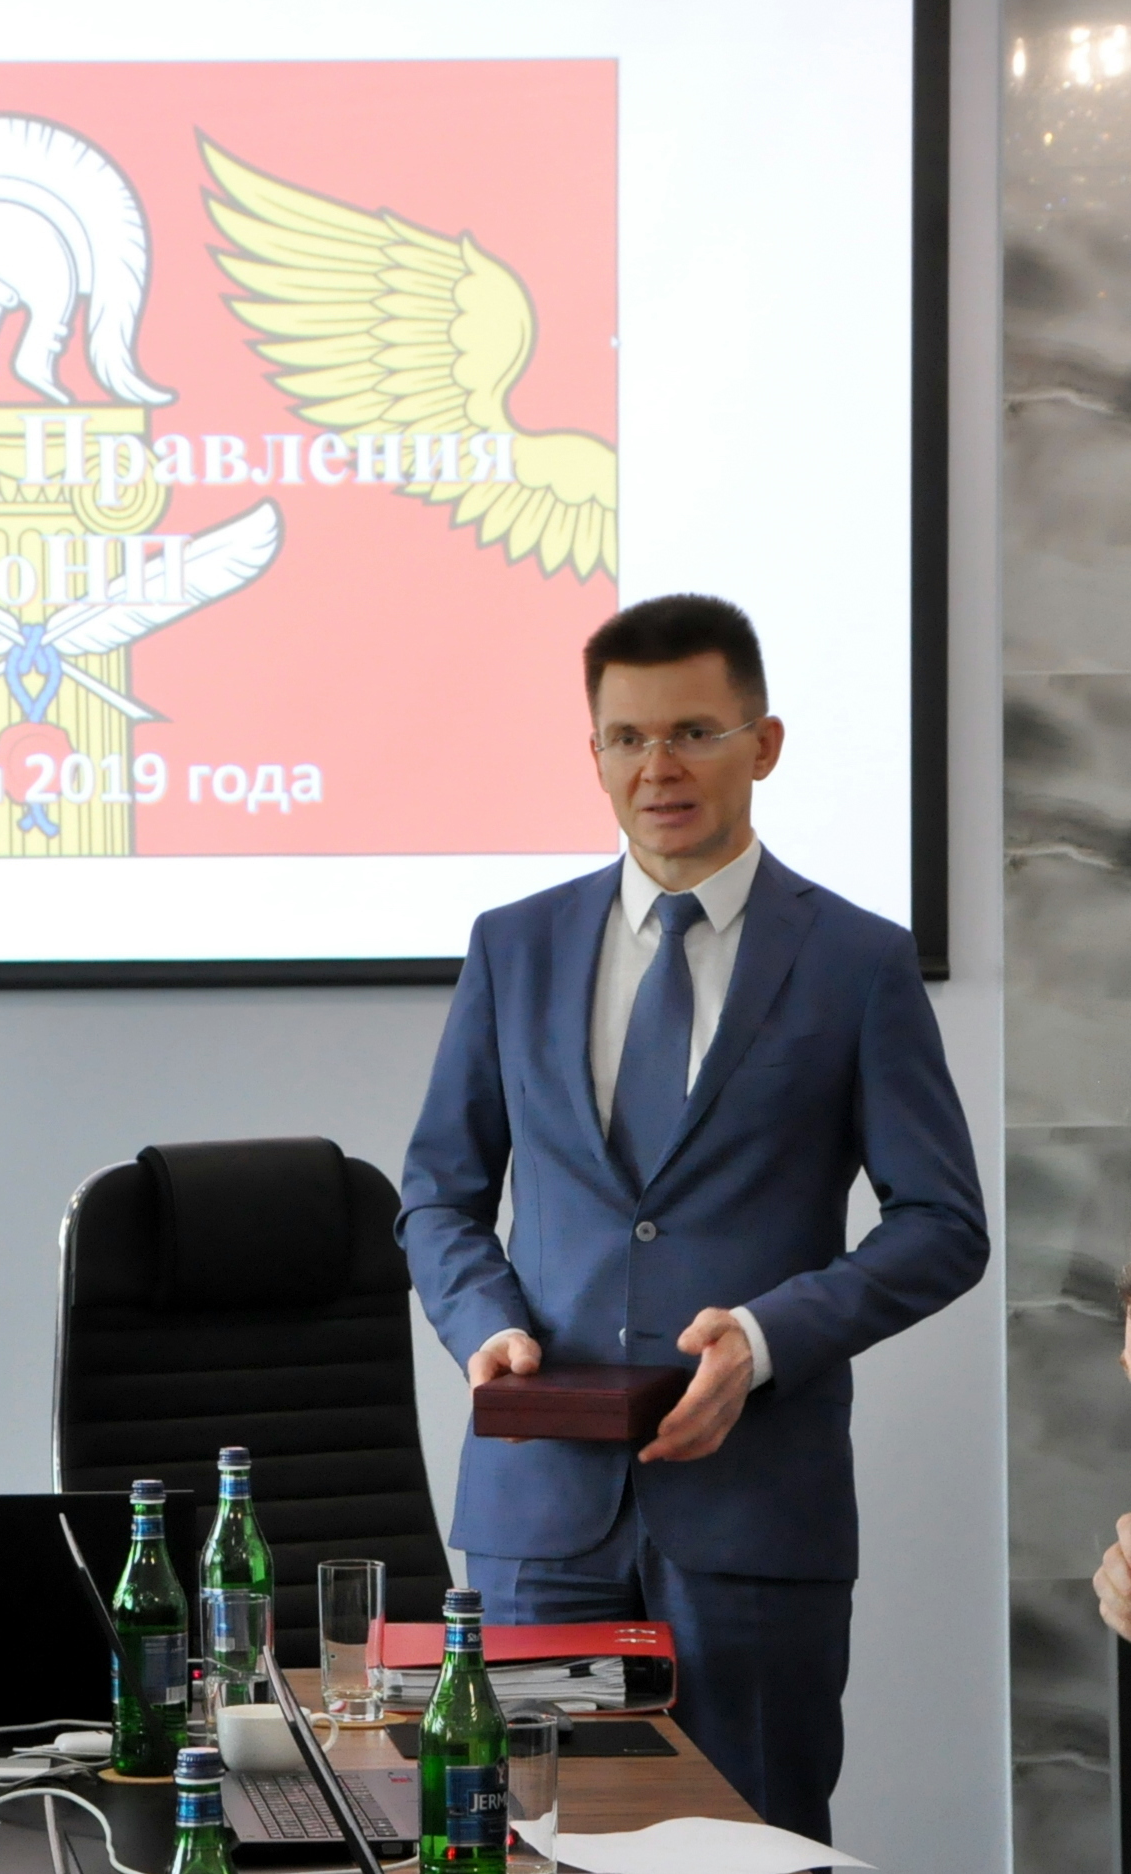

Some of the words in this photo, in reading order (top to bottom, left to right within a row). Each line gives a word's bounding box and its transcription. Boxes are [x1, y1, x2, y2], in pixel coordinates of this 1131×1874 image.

[17, 413, 518, 507] Правления
[23, 751, 168, 805] 2019
[188, 761, 324, 814] года
